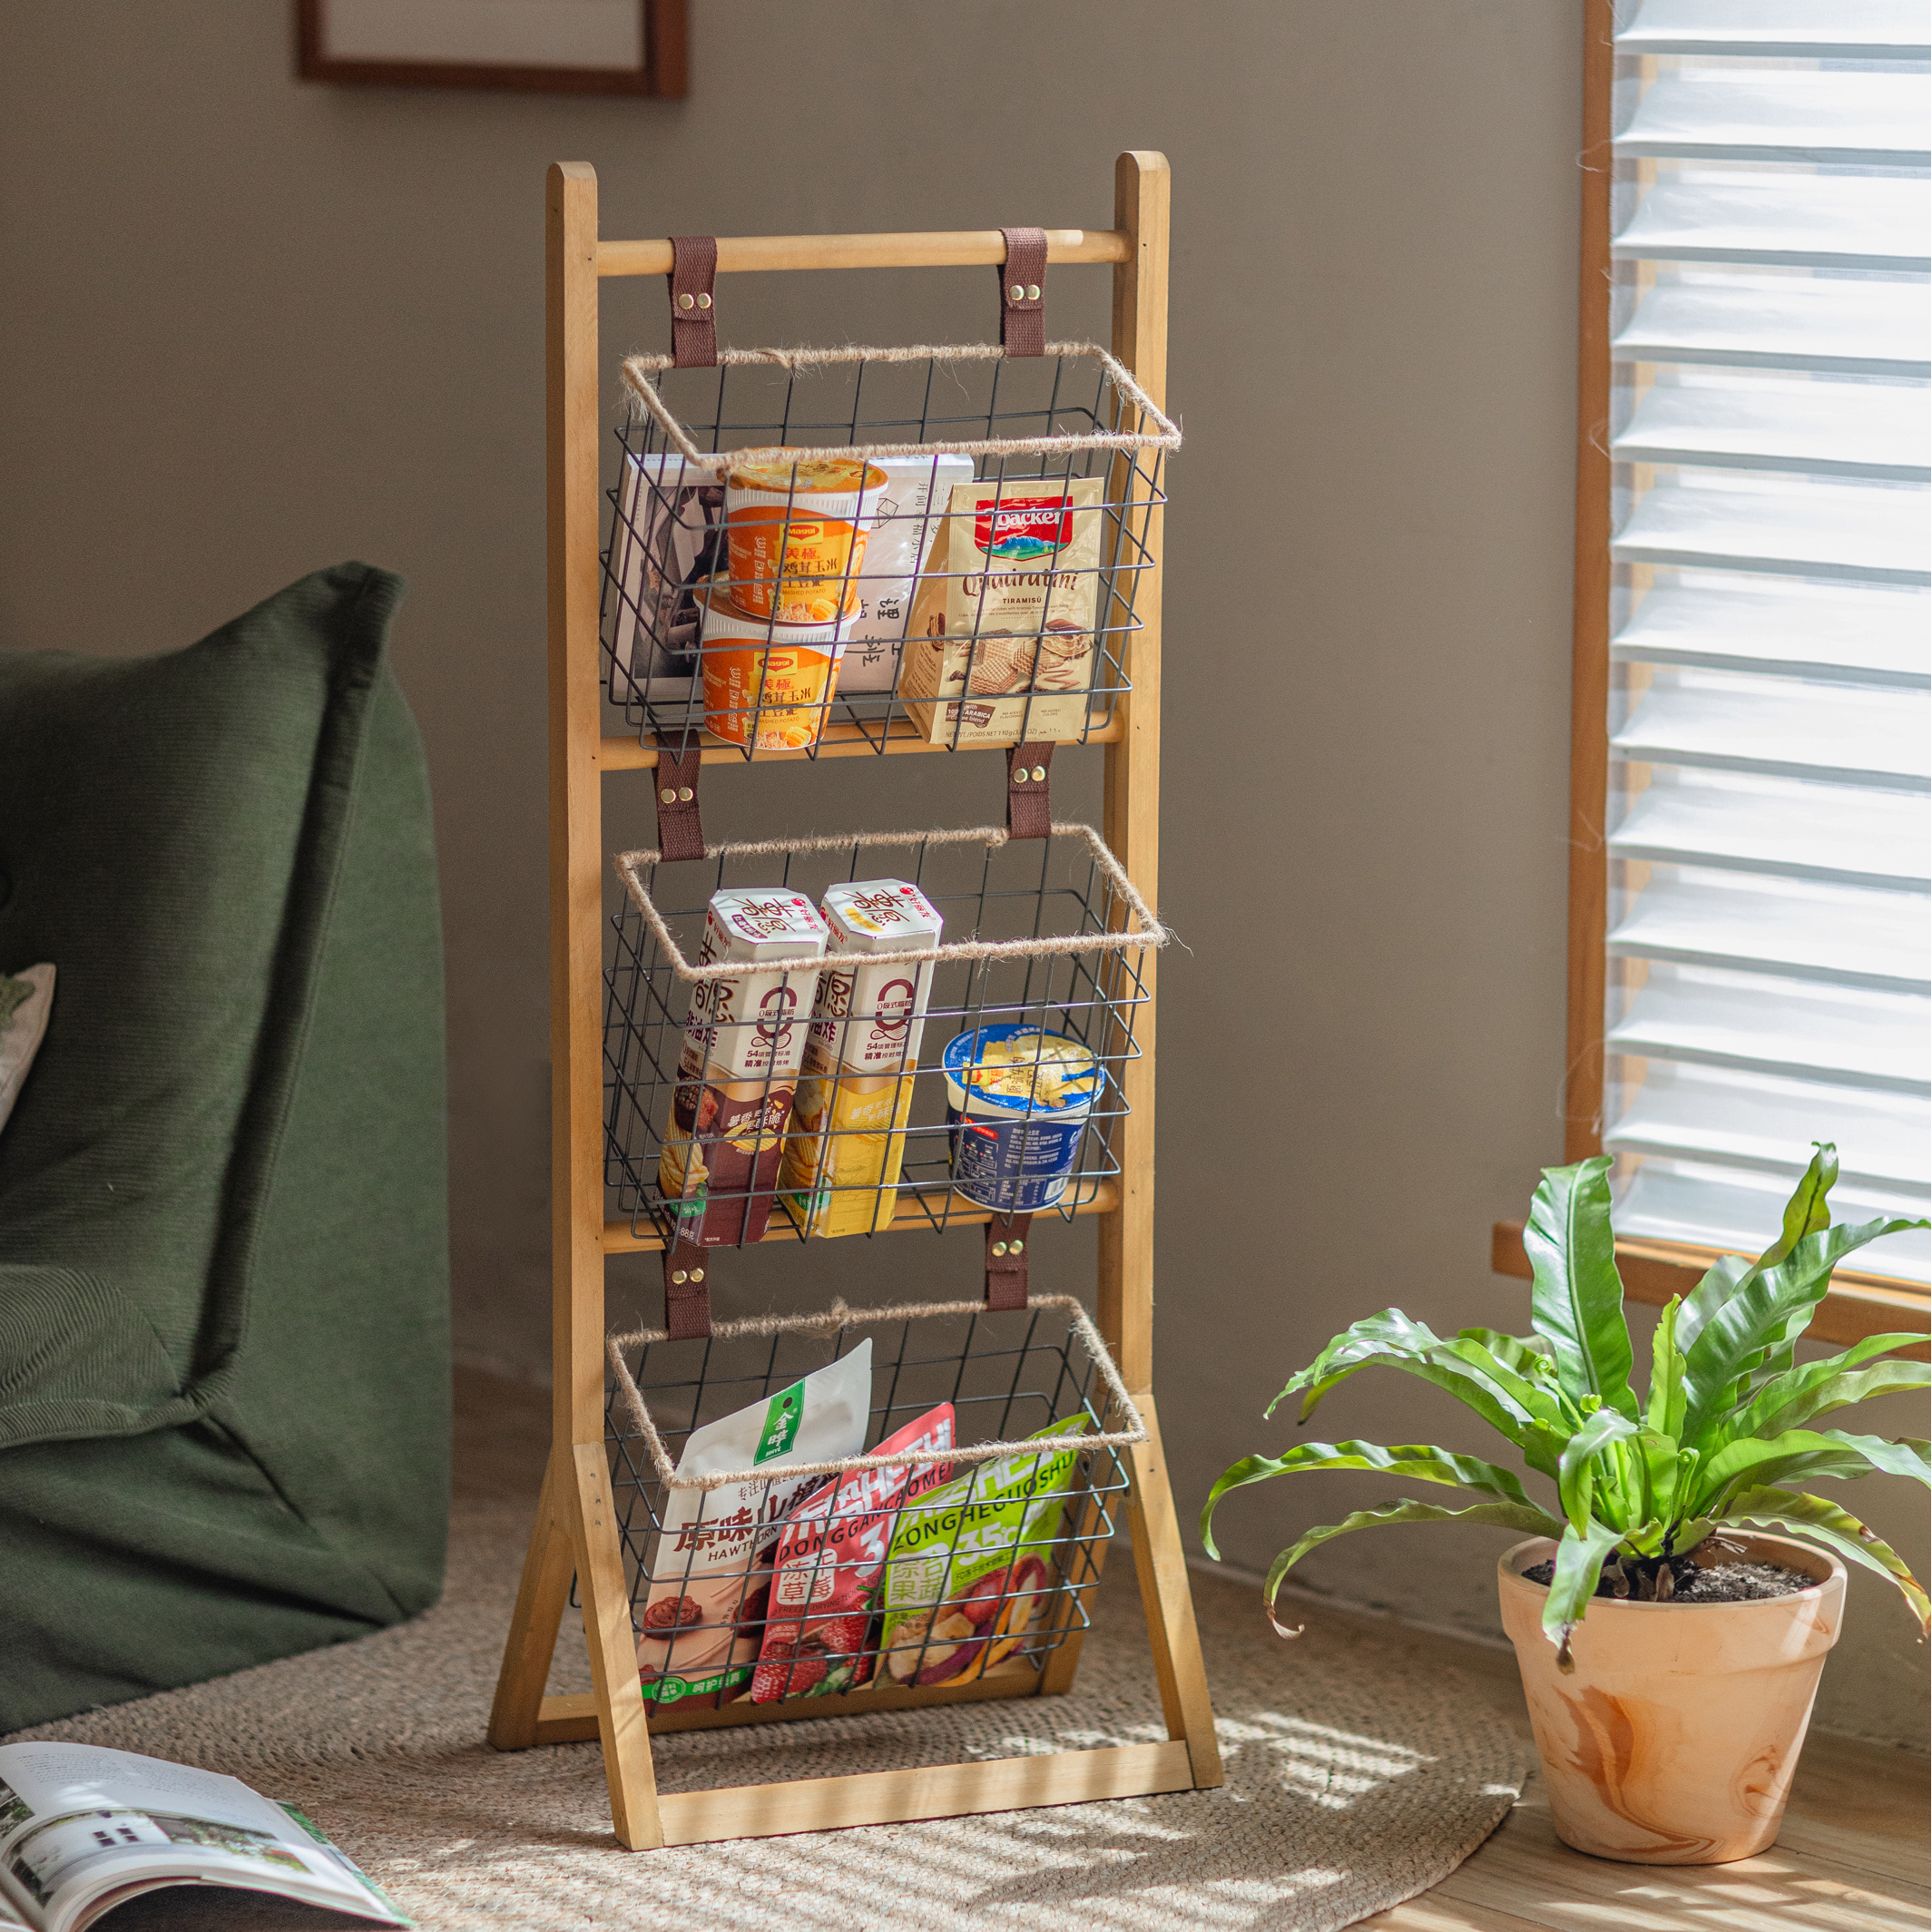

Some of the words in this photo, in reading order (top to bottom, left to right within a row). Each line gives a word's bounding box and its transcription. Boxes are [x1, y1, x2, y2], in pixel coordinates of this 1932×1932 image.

[788, 527, 817, 535] Maggi
[965, 710, 991, 720] ARABICA
[969, 716, 986, 724] blend
